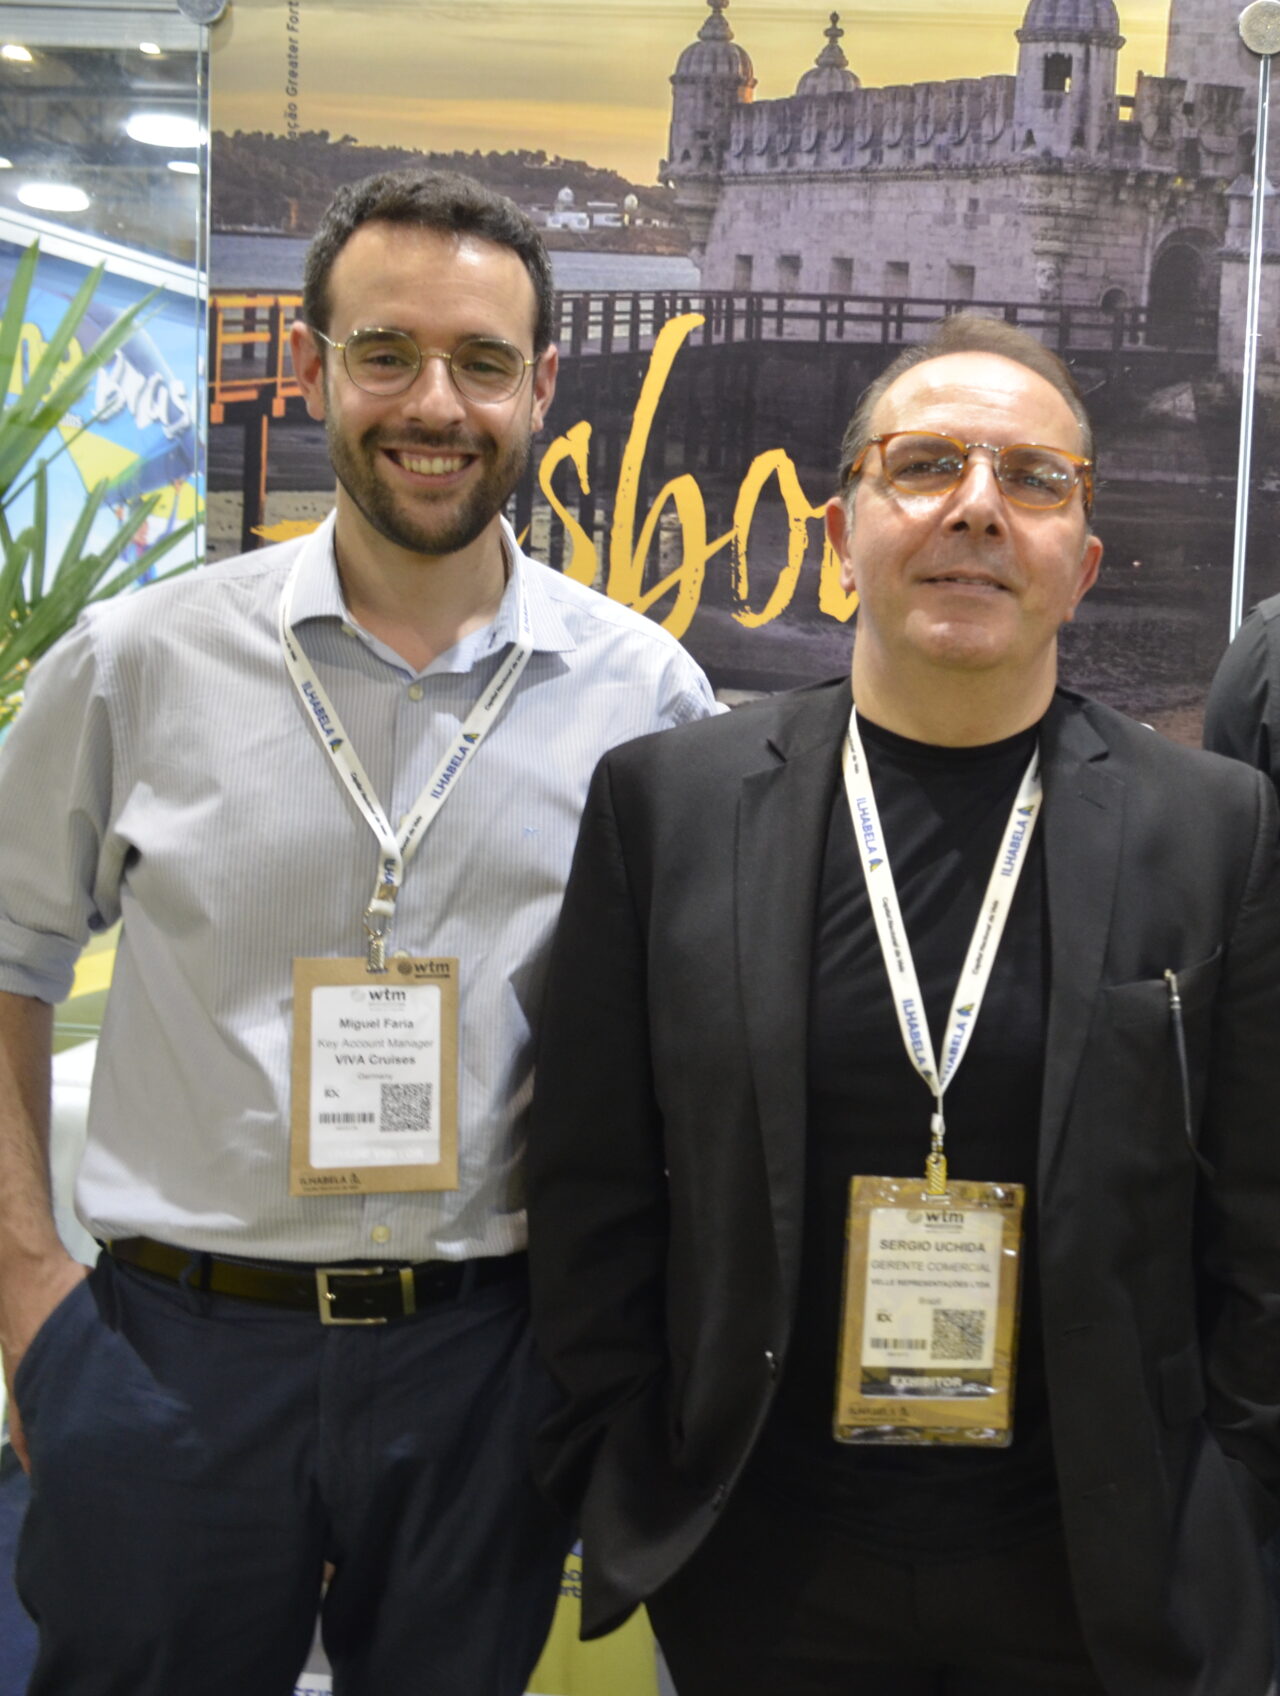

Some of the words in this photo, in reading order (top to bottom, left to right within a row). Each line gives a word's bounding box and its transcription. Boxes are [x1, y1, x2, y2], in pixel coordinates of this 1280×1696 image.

[286, 37, 298, 97] Greater
[302, 681, 334, 737] ILHABELA
[430, 745, 469, 799] ILHABELA
[856, 797, 877, 854] ILHABELA
[1000, 820, 1028, 877] ILHABELA
[414, 960, 450, 973] wtm
[369, 988, 406, 1001] wtm
[339, 1018, 380, 1031] Miguel
[384, 1018, 414, 1029] Faria
[903, 998, 926, 1066] ILHABELA
[318, 1039, 337, 1050] Key
[342, 1038, 384, 1048] Account
[387, 1038, 433, 1050] Manager
[335, 1054, 365, 1065] VIVA
[369, 1054, 416, 1065] Cruises
[926, 1209, 964, 1222] wtm
[880, 1239, 931, 1251] SERGIO
[935, 1242, 986, 1253] UCHIDA
[871, 1260, 924, 1270] GERENTE
[927, 1262, 991, 1272] COMERCIAL
[889, 1375, 963, 1388] EXHIBITOR
